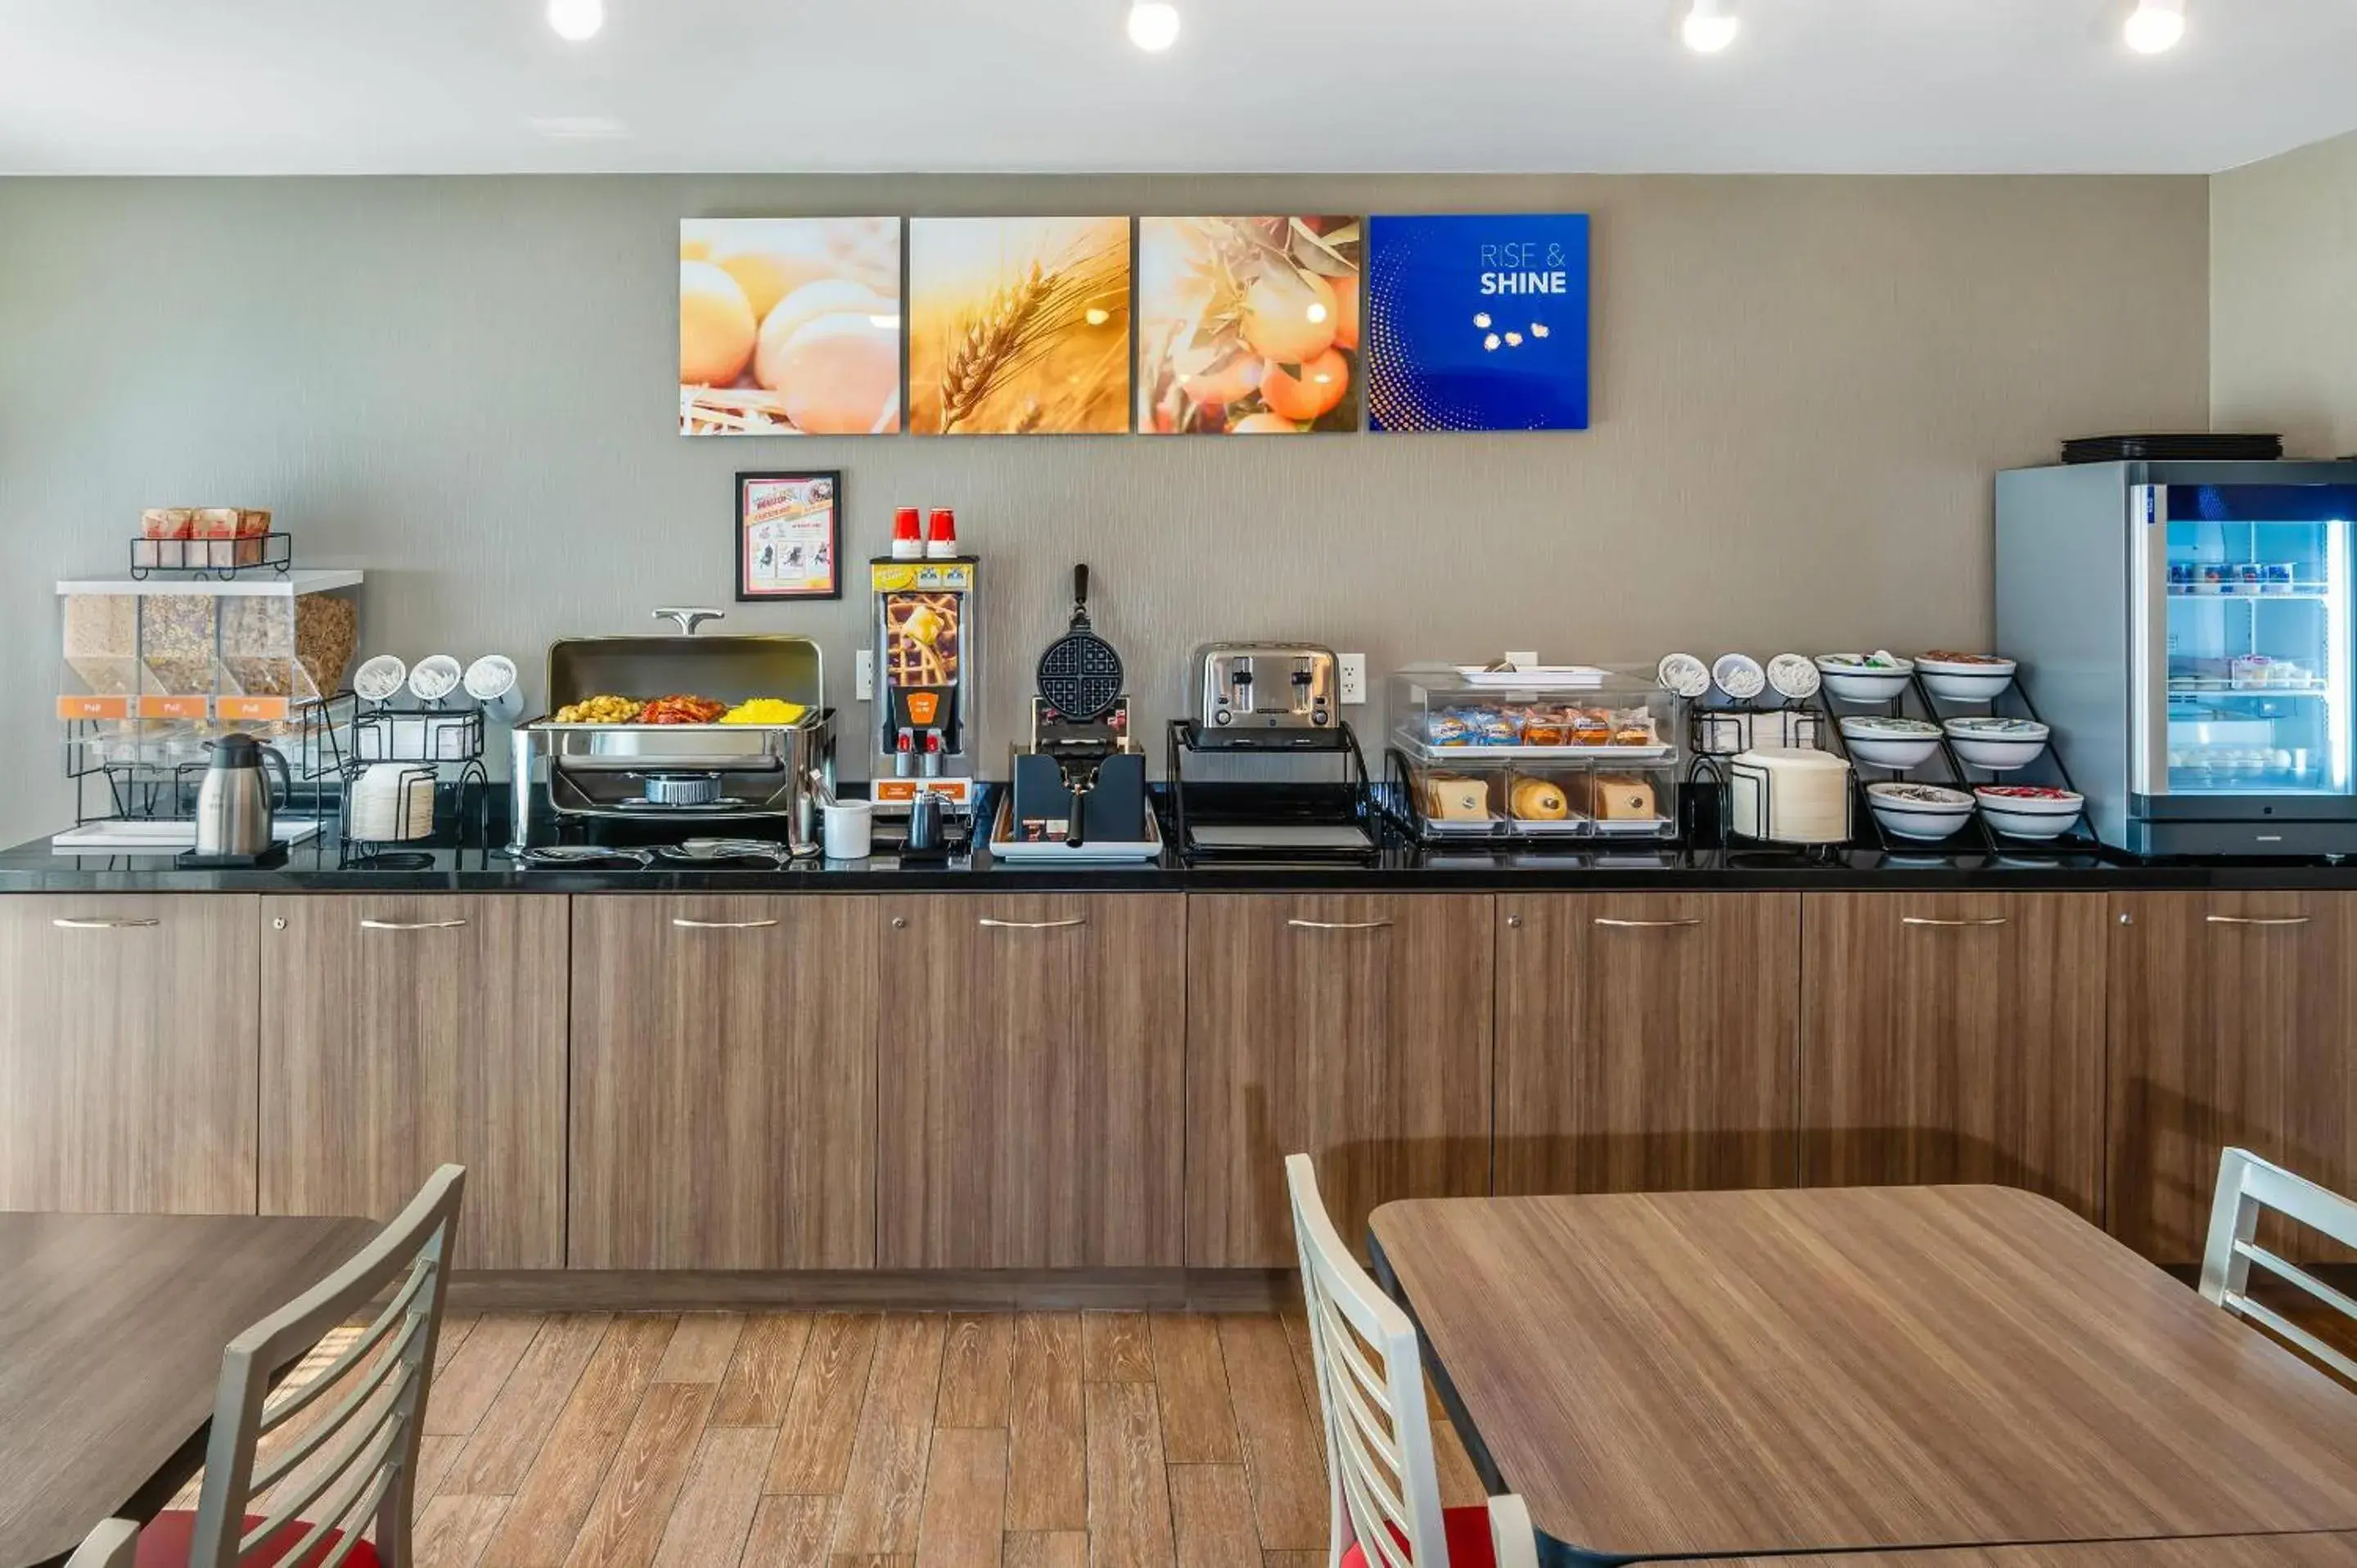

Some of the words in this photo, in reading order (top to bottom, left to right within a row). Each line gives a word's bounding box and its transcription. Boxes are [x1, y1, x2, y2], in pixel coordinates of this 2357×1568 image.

[1480, 242, 1537, 268] RISE
[1547, 242, 1566, 268] &
[1480, 271, 1567, 295] SHINE
